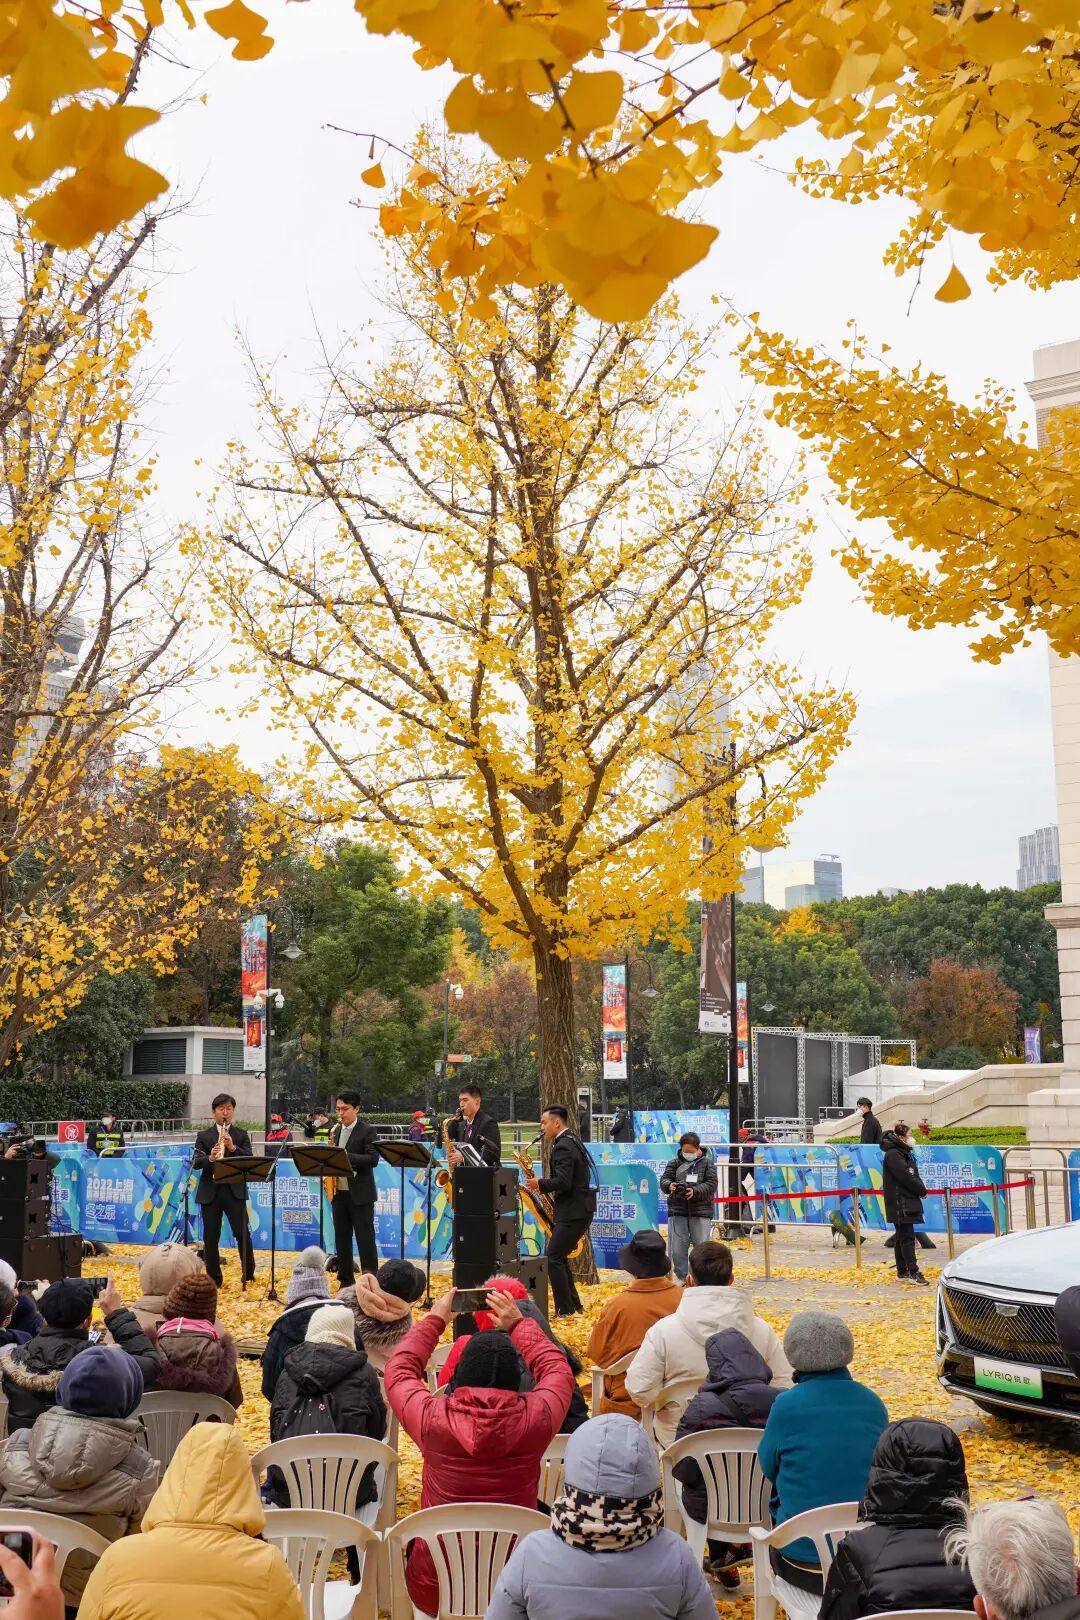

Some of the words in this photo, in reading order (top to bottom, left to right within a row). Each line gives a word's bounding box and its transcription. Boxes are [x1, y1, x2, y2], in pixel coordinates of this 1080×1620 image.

[86, 1203, 116, 1220] 冬之乐
[982, 1368, 1013, 1383] LYRIQ
